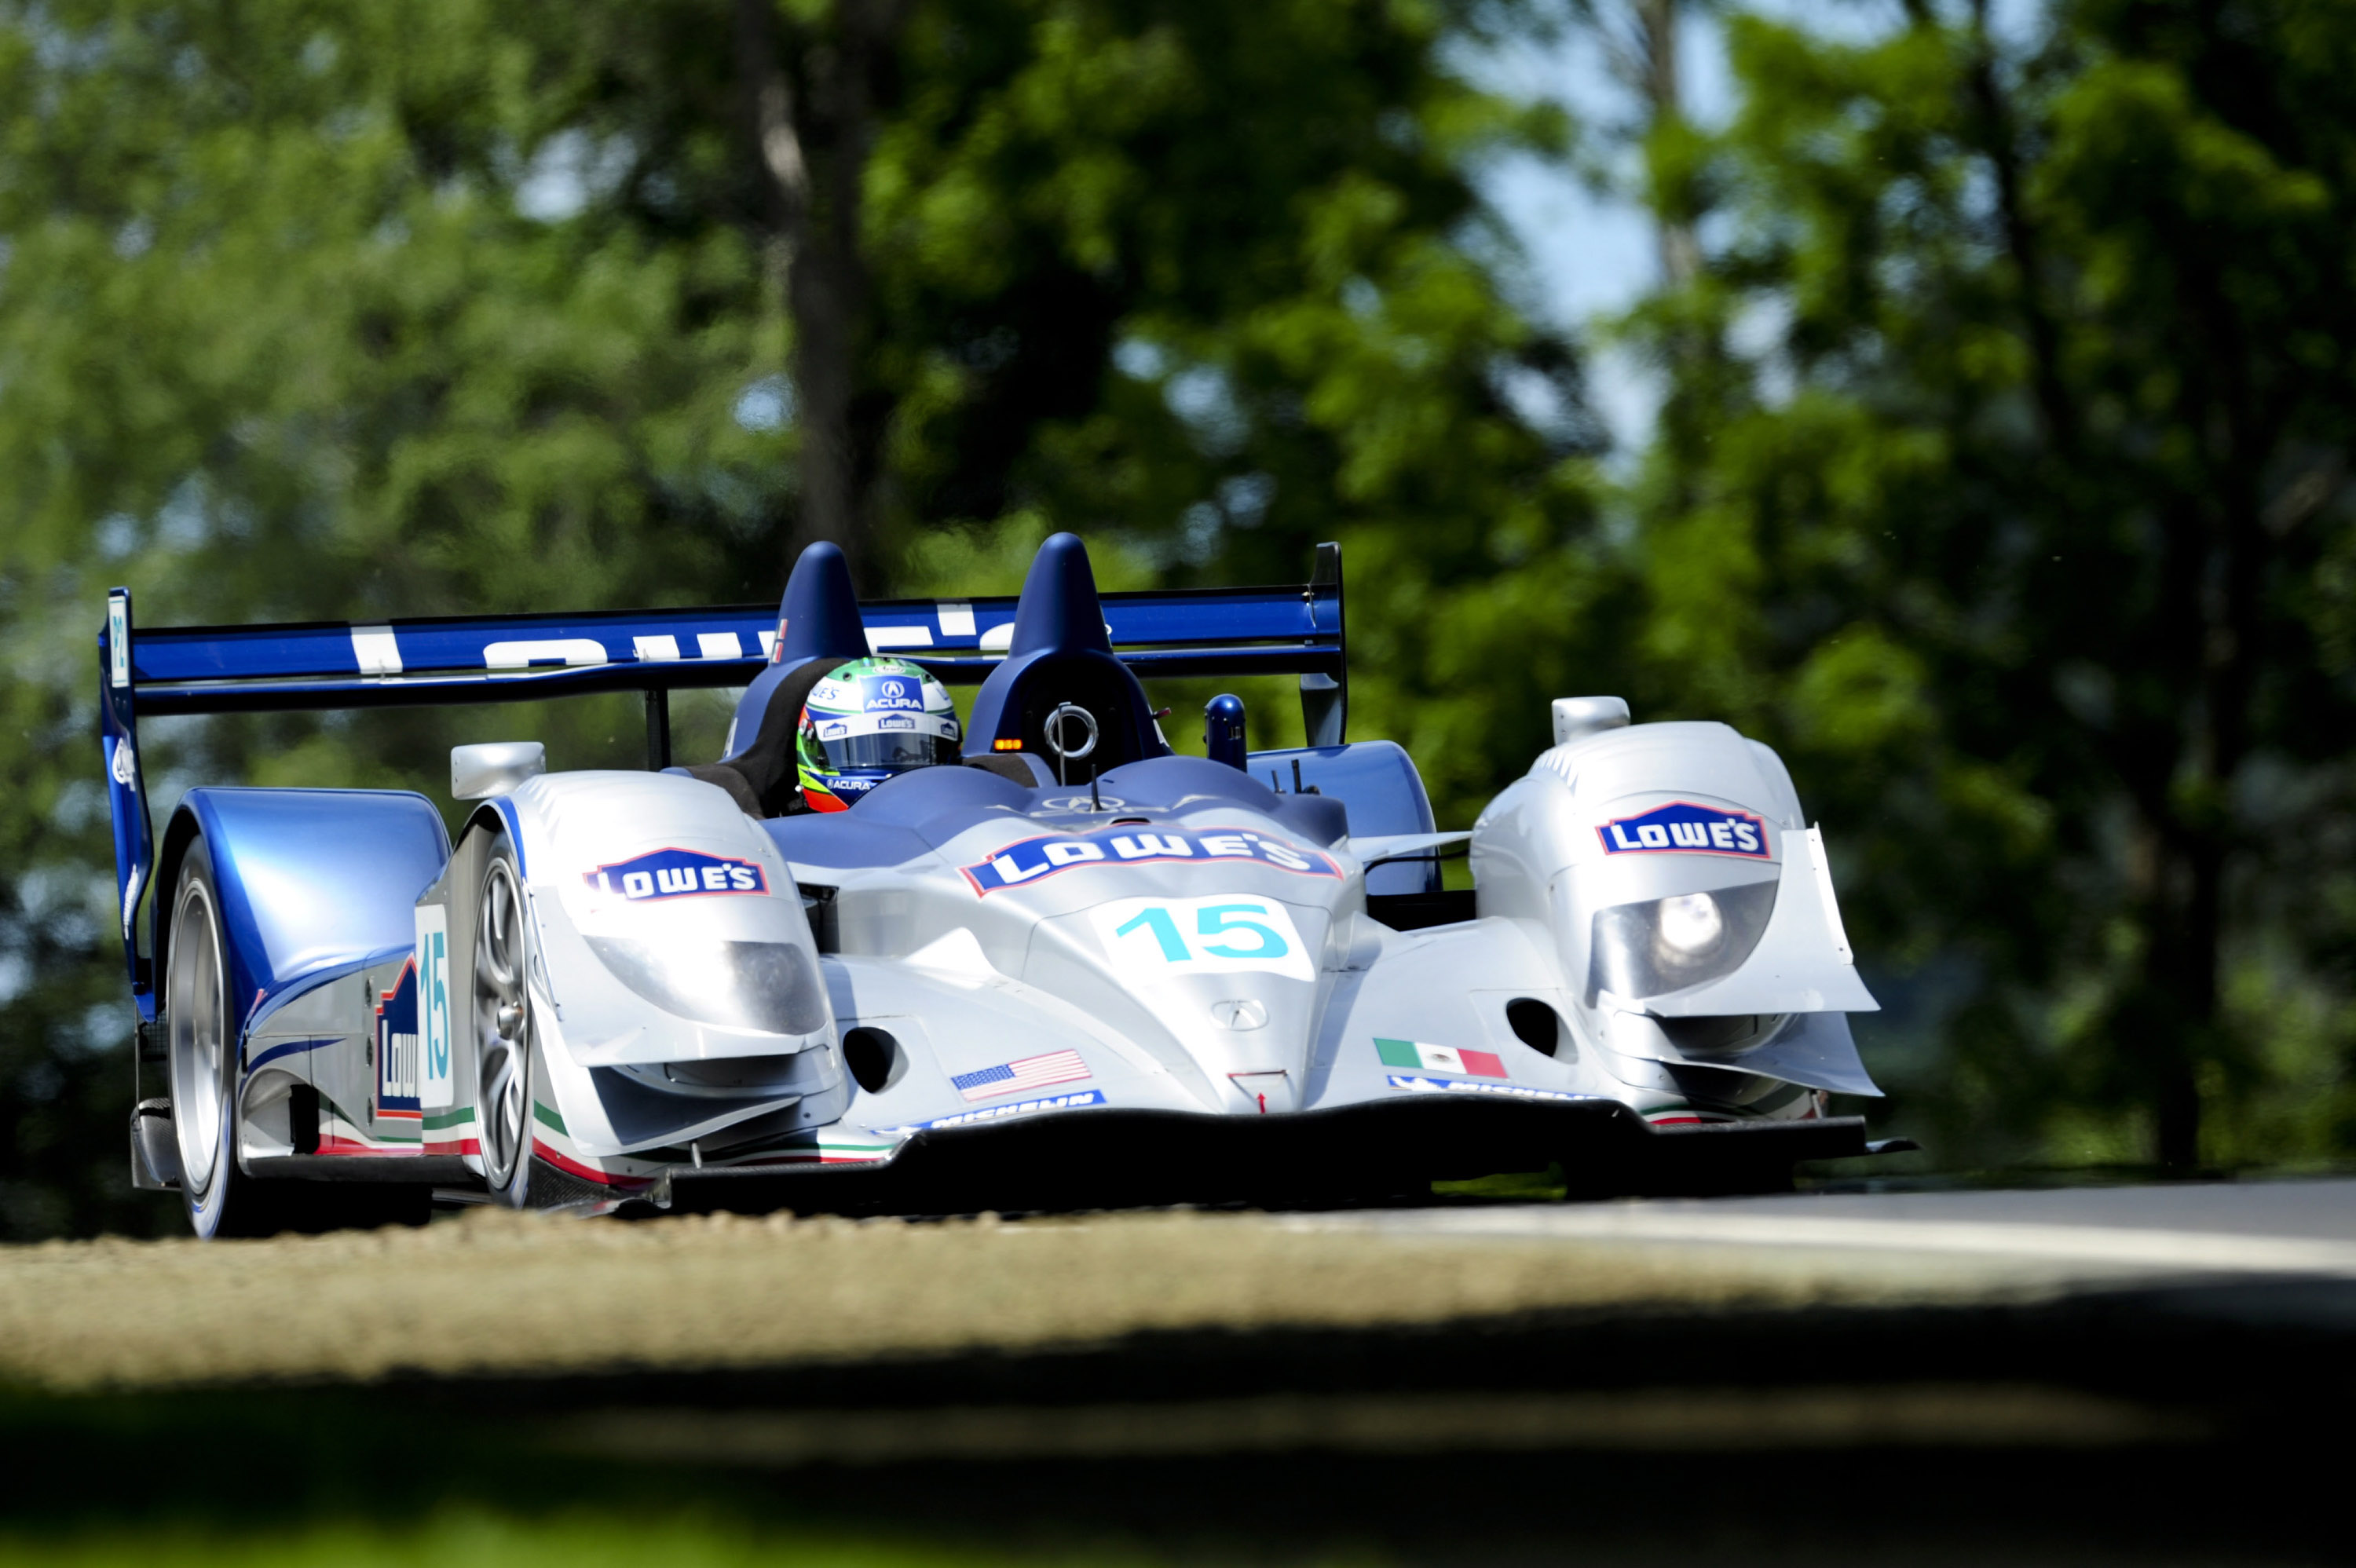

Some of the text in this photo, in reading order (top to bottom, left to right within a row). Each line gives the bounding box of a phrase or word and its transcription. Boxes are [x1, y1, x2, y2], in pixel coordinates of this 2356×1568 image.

[866, 698, 922, 710] ACURA
[833, 780, 871, 791] ACURA
[1611, 818, 1759, 852] LOWE'S
[991, 833, 1311, 884] LOWE'S
[1116, 904, 1290, 963] 15
[420, 932, 448, 1080] 15
[930, 1092, 1094, 1129] MICHELIN
